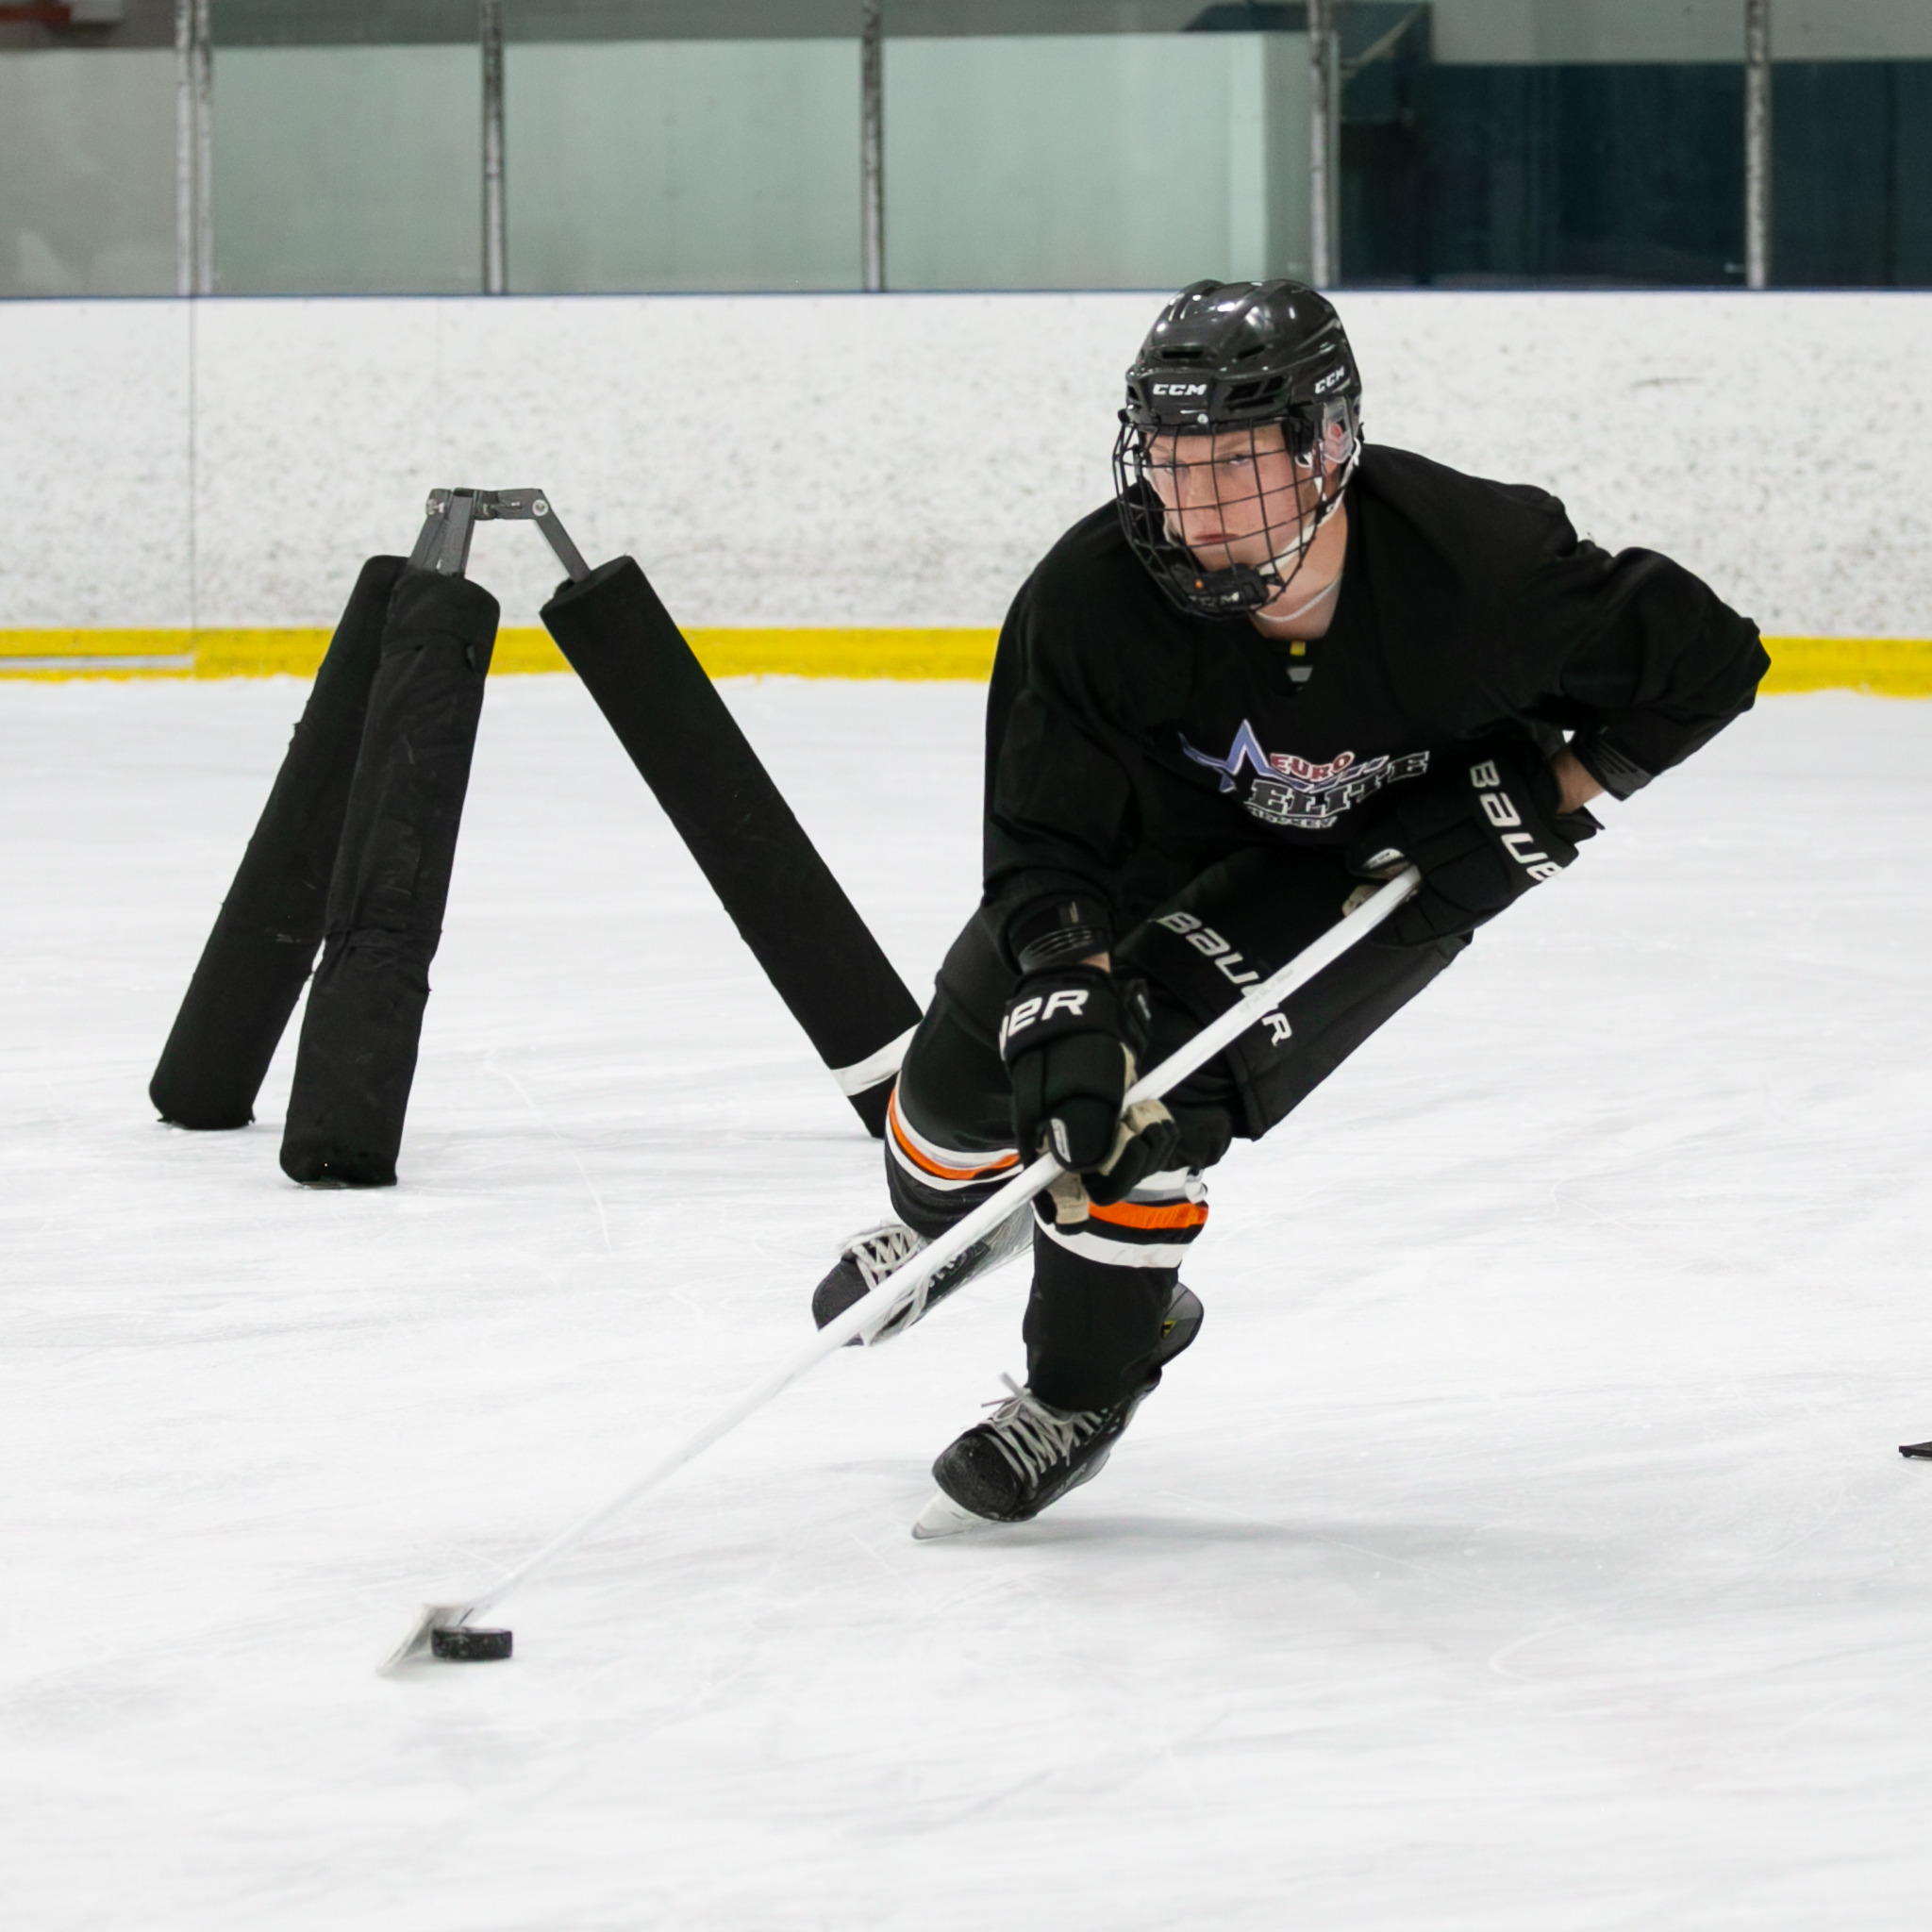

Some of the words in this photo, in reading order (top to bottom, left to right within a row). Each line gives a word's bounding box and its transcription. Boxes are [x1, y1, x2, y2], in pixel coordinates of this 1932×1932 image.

[1152, 384, 1207, 396] CCM
[1315, 366, 1344, 393] CCM
[1269, 751, 1356, 782] EURO
[1244, 750, 1431, 819] ELITE
